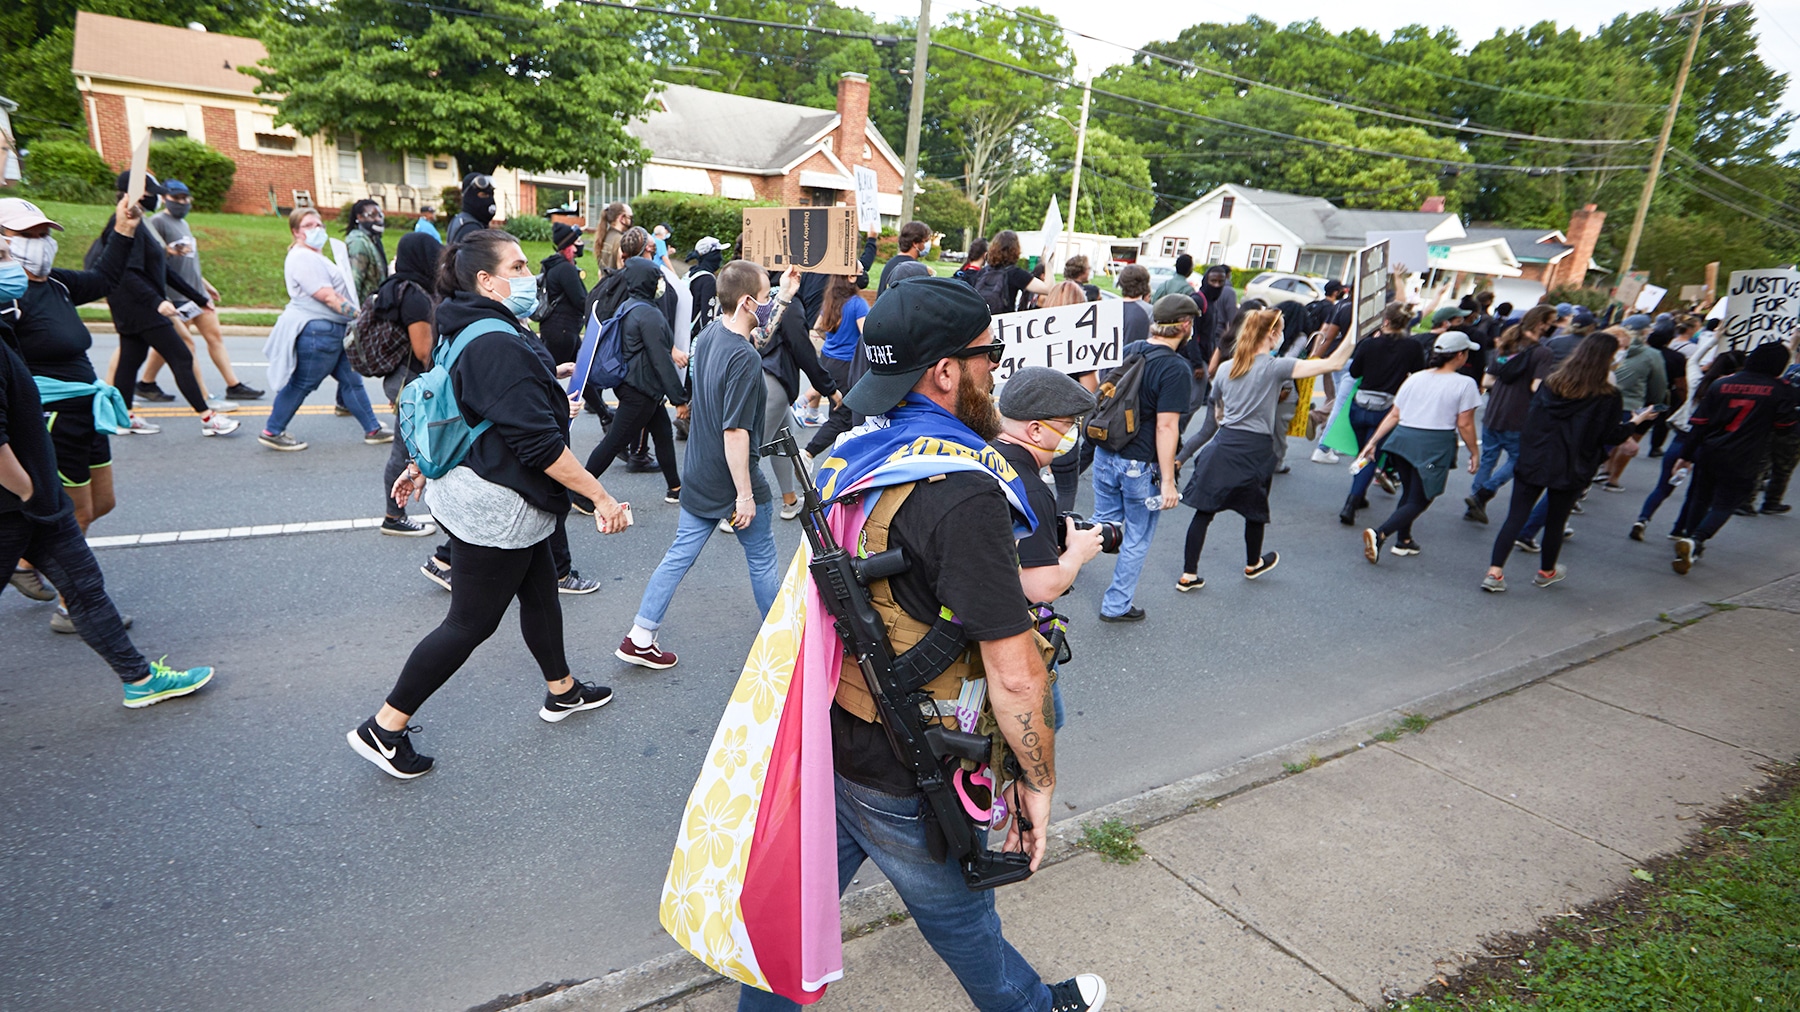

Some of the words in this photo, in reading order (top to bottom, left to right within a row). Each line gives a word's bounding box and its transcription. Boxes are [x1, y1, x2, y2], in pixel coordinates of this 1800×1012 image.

[1753, 295, 1789, 313] FOR
[994, 316, 1061, 343] tice
[1075, 304, 1098, 339] 4
[1046, 326, 1119, 368] Floyd
[1724, 398, 1756, 433] 7
